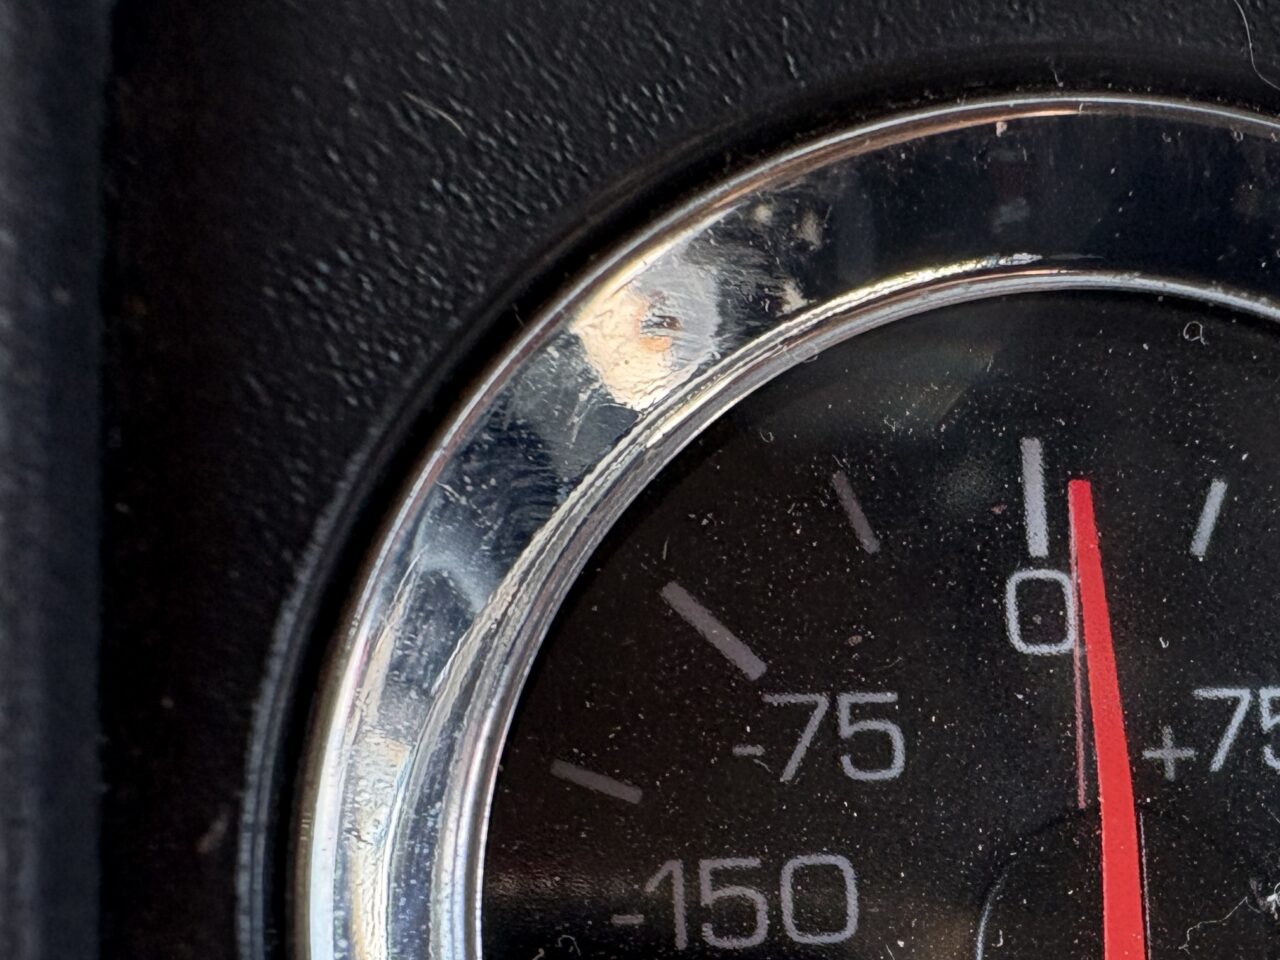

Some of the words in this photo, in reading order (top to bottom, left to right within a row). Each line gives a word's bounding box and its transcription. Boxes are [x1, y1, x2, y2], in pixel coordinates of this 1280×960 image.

[1004, 569, 1079, 655] 0
[733, 692, 904, 782] -75
[613, 853, 857, 950] -150
